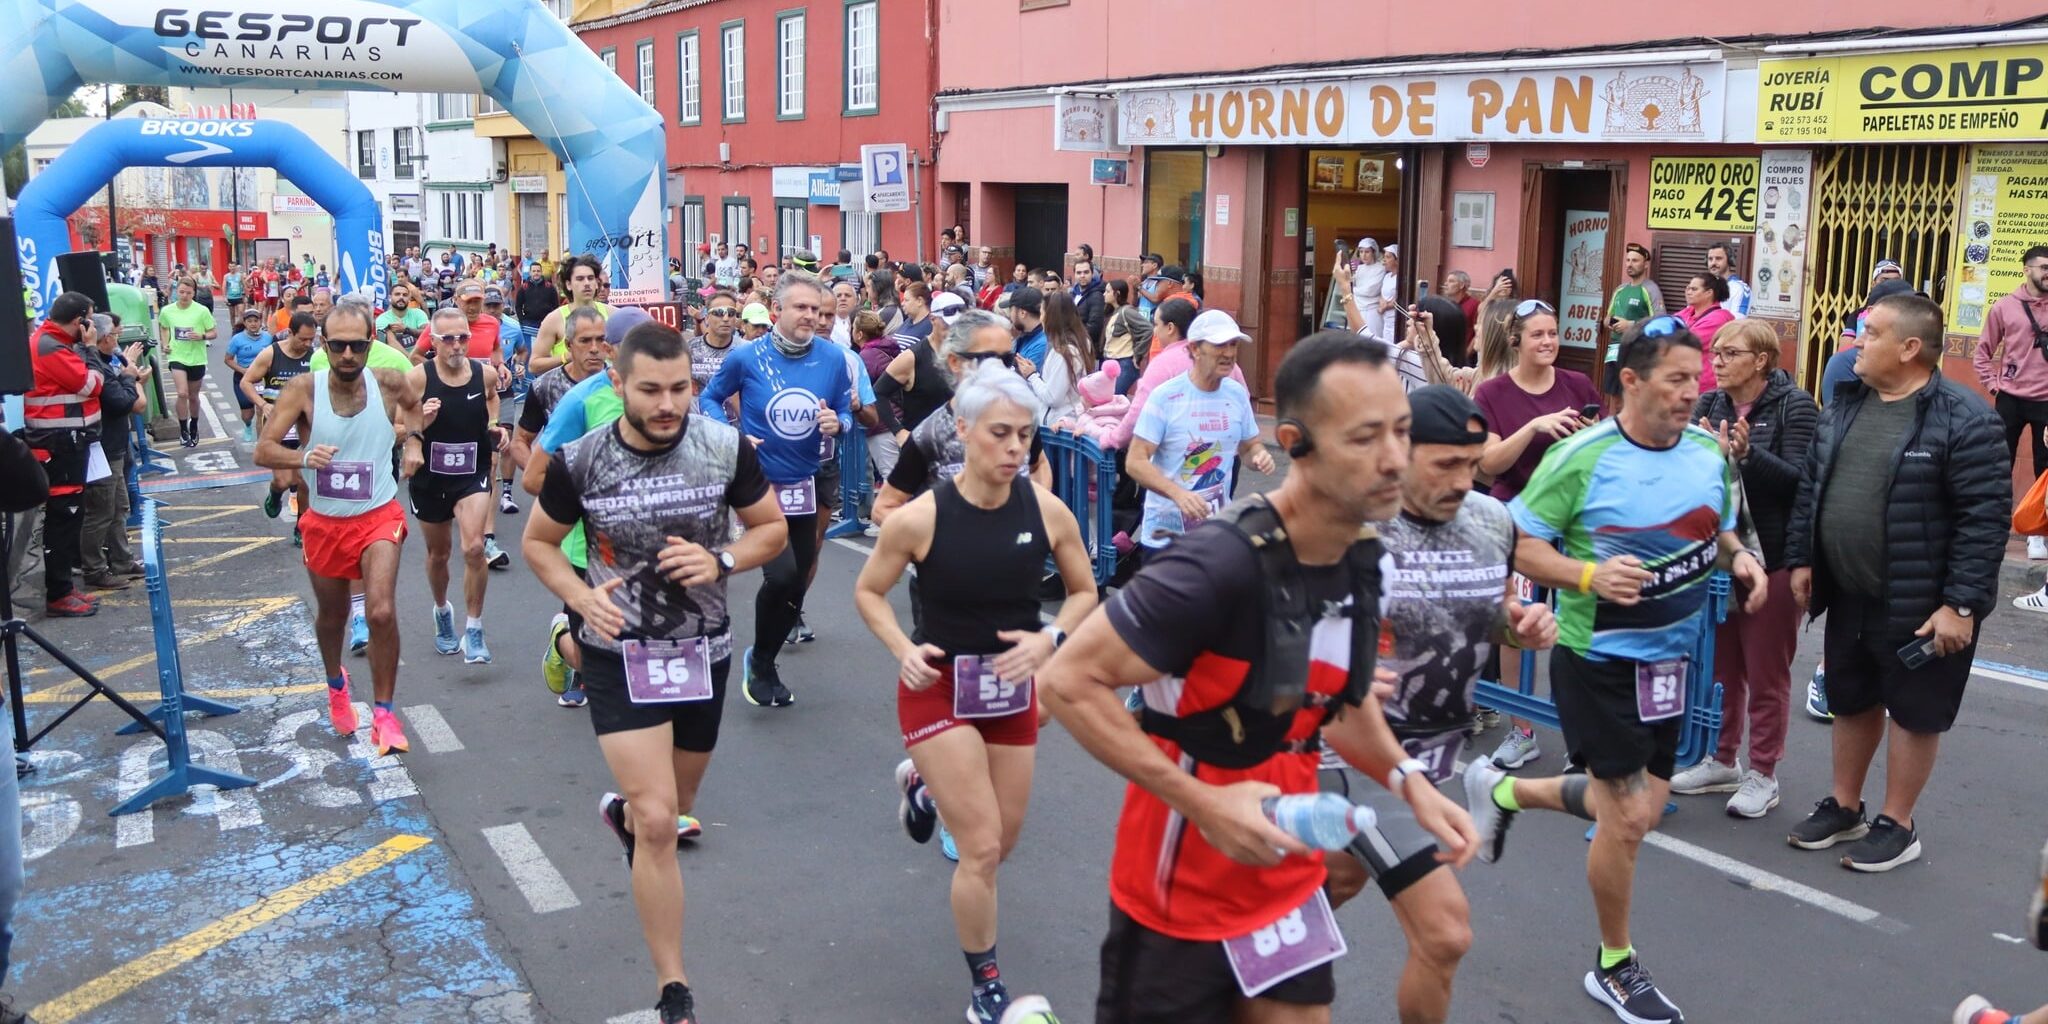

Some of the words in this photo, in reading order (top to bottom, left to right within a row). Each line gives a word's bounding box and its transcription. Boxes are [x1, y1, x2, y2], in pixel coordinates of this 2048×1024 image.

[185, 41, 381, 62] CANARIAS
[179, 65, 403, 81] WWW.GESPORTCANARIAS.COM
[1763, 66, 1831, 86] JOYERÍA
[1189, 85, 1345, 140] HORNO
[1369, 80, 1437, 137] DE
[1468, 76, 1594, 135] PAN
[1770, 87, 1824, 112] RUBÍ
[141, 120, 257, 137] BROOKS
[1780, 116, 1795, 125] 922
[1796, 116, 1811, 125] 573
[1813, 115, 1828, 124] 452
[1863, 112, 1934, 132] PAPELETAS
[1939, 113, 1956, 130] DE
[1960, 108, 2019, 129] EMPEÑO
[1780, 127, 1794, 136] 627
[1796, 127, 1810, 135] 195
[1812, 126, 1827, 135] 104
[1978, 149, 2013, 157] TENEMOS
[875, 153, 898, 183] P
[1654, 162, 1716, 186] COMPRO
[1721, 162, 1754, 186] ORO
[1767, 166, 1804, 174] COMPRO
[811, 178, 840, 197] Allianz
[1765, 177, 1804, 185] RELOJES
[2009, 189, 2048, 199] HASTA
[1651, 207, 1692, 220] HASTA
[1653, 189, 1685, 201] PAGO
[1695, 187, 1757, 223] 42€
[1569, 216, 1608, 237] HORNO
[1992, 239, 2024, 247] COMPRO
[1990, 255, 2016, 263] Cartier,
[16, 235, 44, 326] ROOKS
[1990, 270, 2024, 278] COMPRO
[1564, 327, 1592, 343] 6:30
[444, 453, 466, 467] 83
[330, 473, 361, 491] 84
[620, 473, 686, 491] XXXIII
[780, 489, 805, 506] 65
[1402, 550, 1475, 563] XXXIII
[647, 657, 690, 685] 56
[1653, 674, 1677, 702] 52
